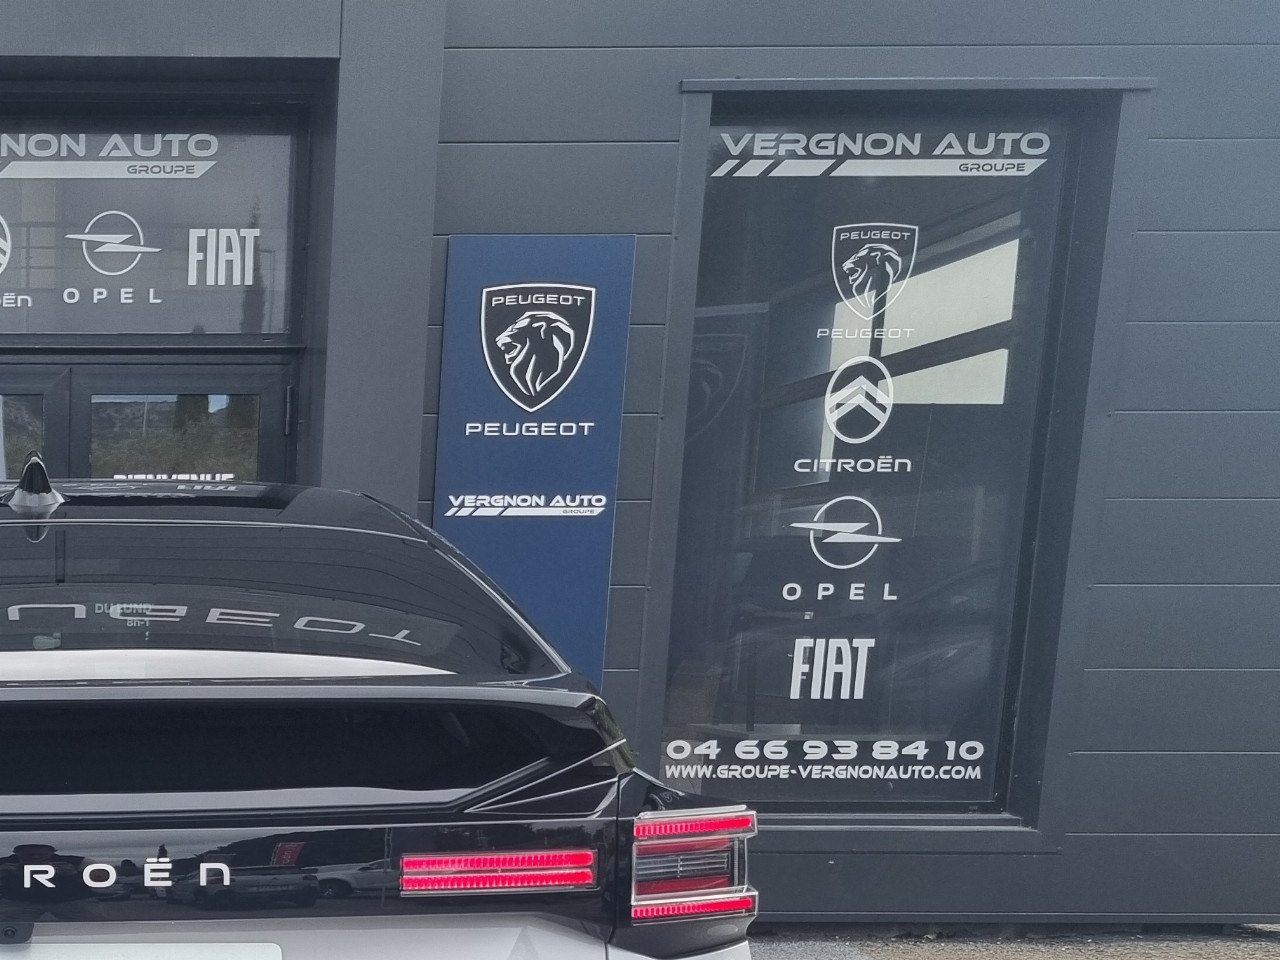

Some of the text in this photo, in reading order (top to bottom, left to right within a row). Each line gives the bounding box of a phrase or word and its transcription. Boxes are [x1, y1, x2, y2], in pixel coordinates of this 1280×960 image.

[98, 133, 219, 157] AUTO
[720, 132, 1051, 156] VERGNON AUTO
[127, 164, 196, 175] GROUPE
[958, 162, 1026, 173] GROUPE
[839, 230, 911, 241] PEUGEOT
[187, 228, 261, 286] FIAT
[62, 287, 163, 304] OPEL
[491, 294, 586, 307] PEUGEOT
[816, 328, 916, 339] PEUGEOT
[465, 422, 595, 436] PEUGEOT
[793, 455, 912, 473] CITROËN
[448, 495, 607, 507] VERGNON AUTO
[782, 583, 898, 601] OPEL
[789, 638, 876, 700] FIAT
[666, 739, 984, 760] 04 66 93 84 10
[665, 764, 981, 779] WWW.GROUPE-VERGNONAUTO.COM
